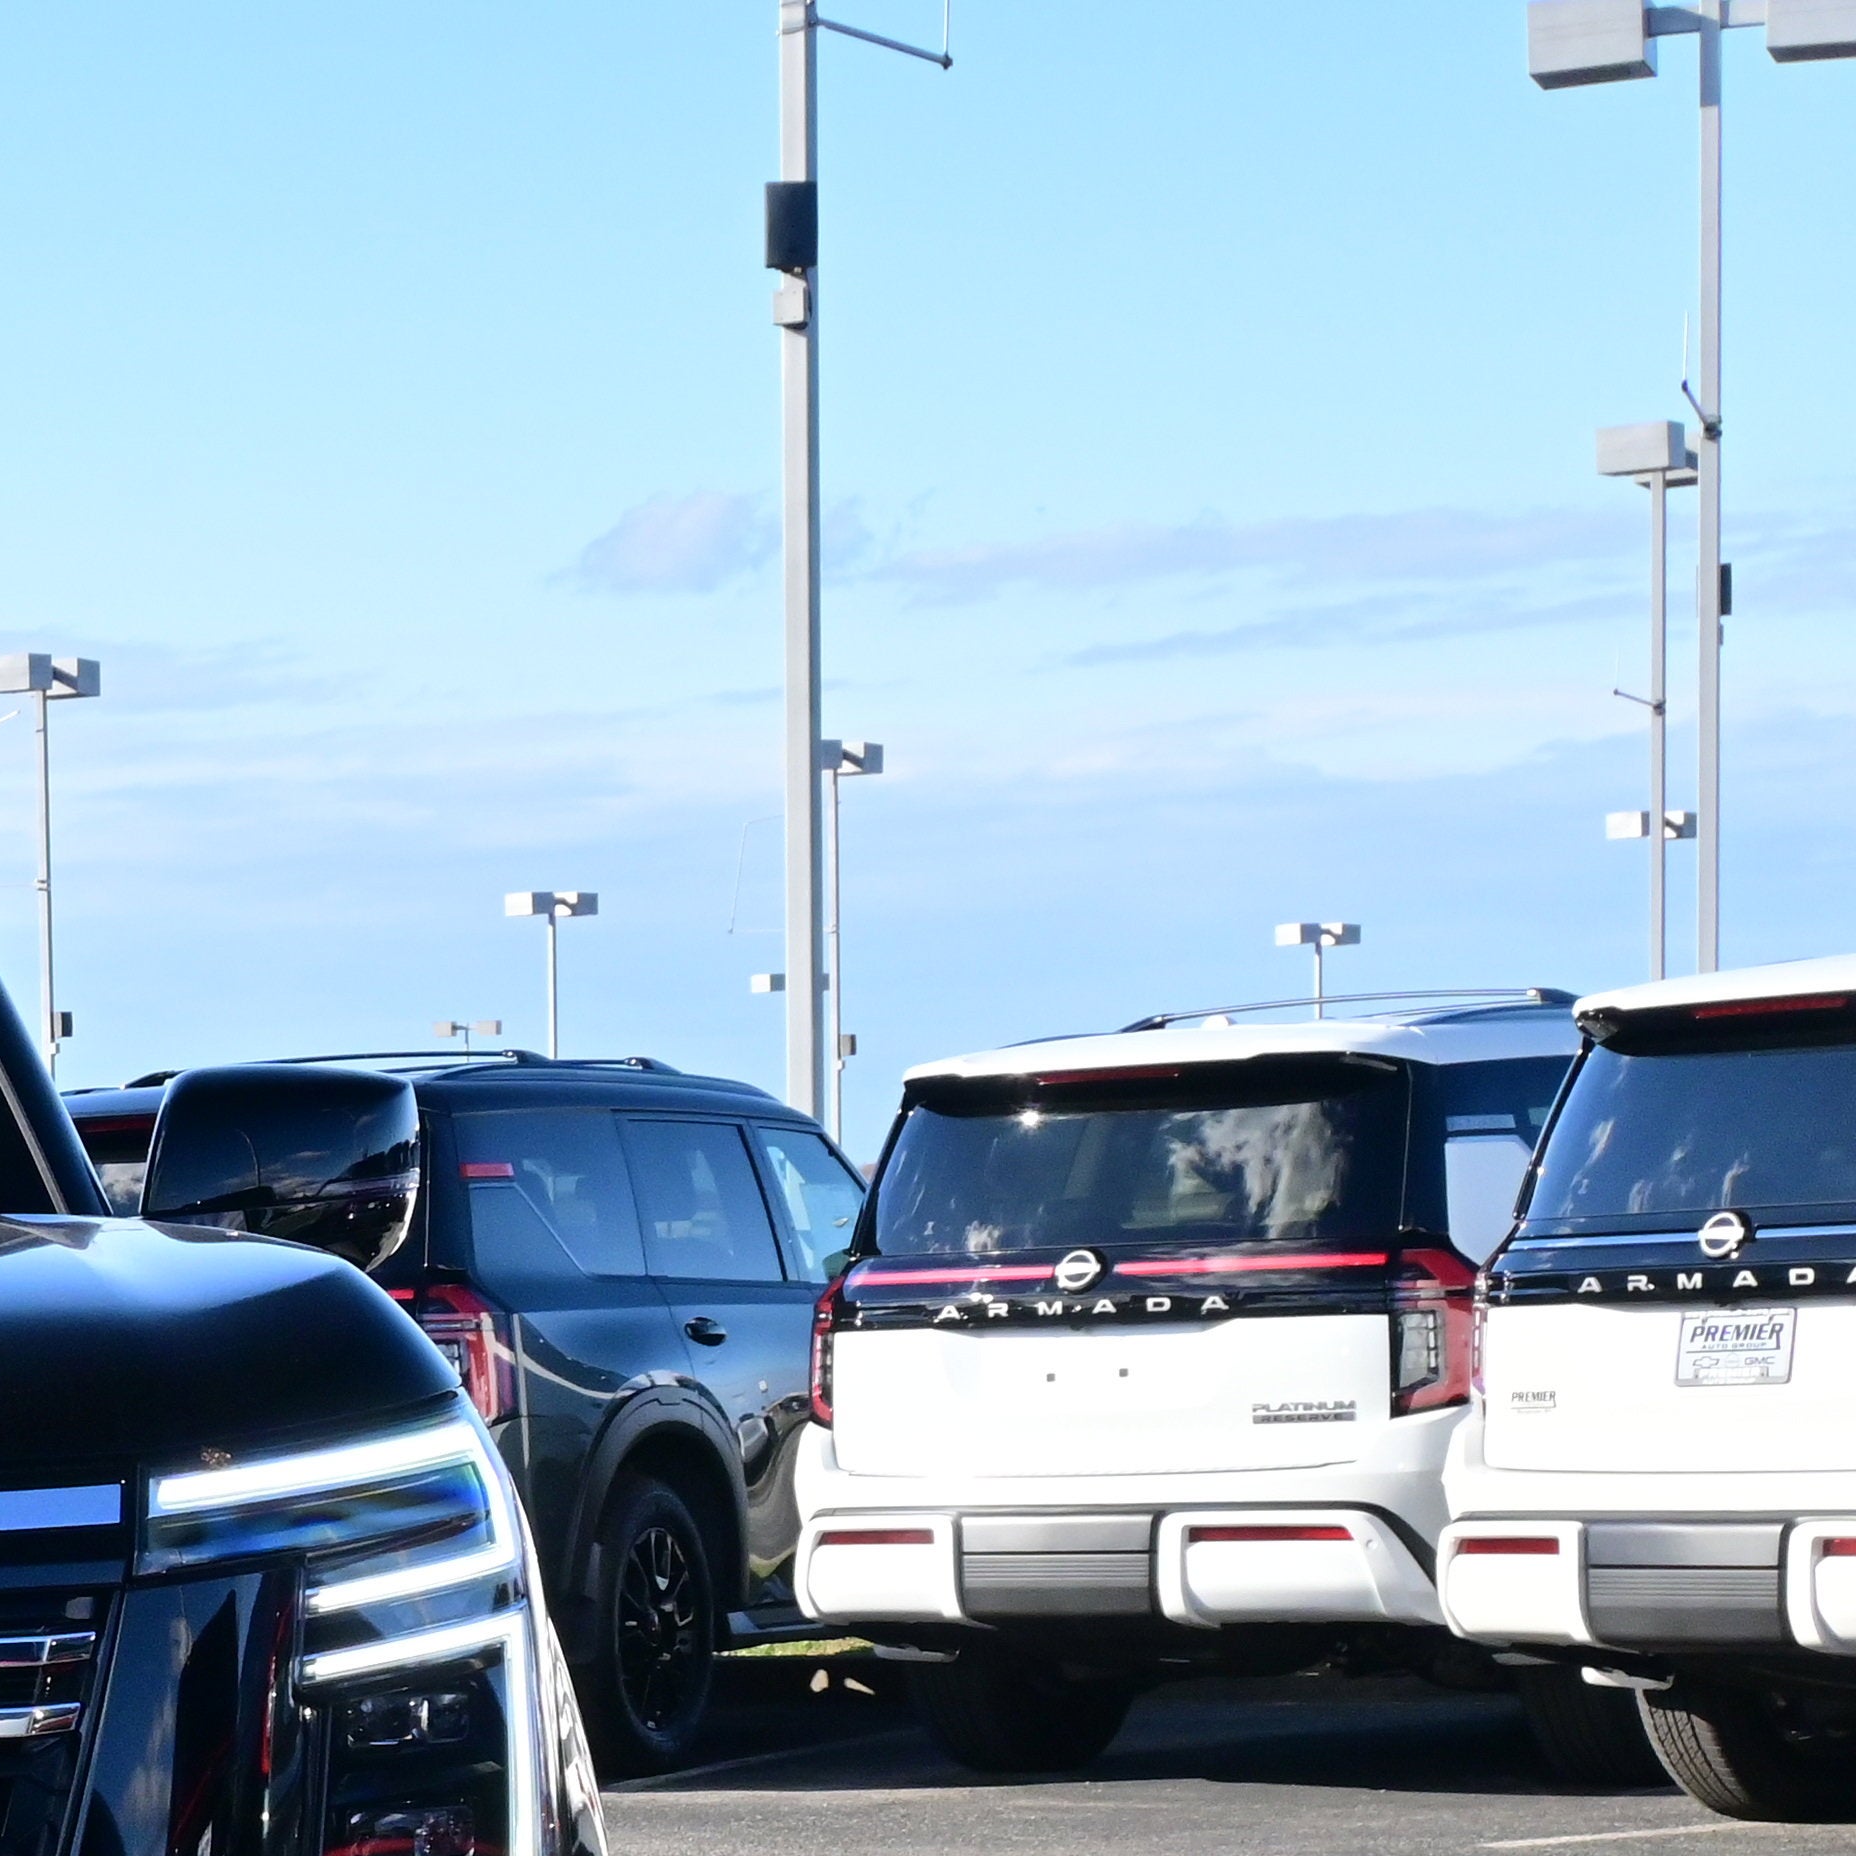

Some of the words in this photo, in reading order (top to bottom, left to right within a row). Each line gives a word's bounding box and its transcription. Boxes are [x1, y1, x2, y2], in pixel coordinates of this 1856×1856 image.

[934, 1296, 1230, 1322] ARMADA
[1689, 1322, 1784, 1343] PREMIER
[1744, 1356, 1776, 1365] GMC
[1511, 1391, 1556, 1402] PREMIER
[1252, 1400, 1357, 1413] PLATINUM
[1260, 1413, 1344, 1423] RESERVE
